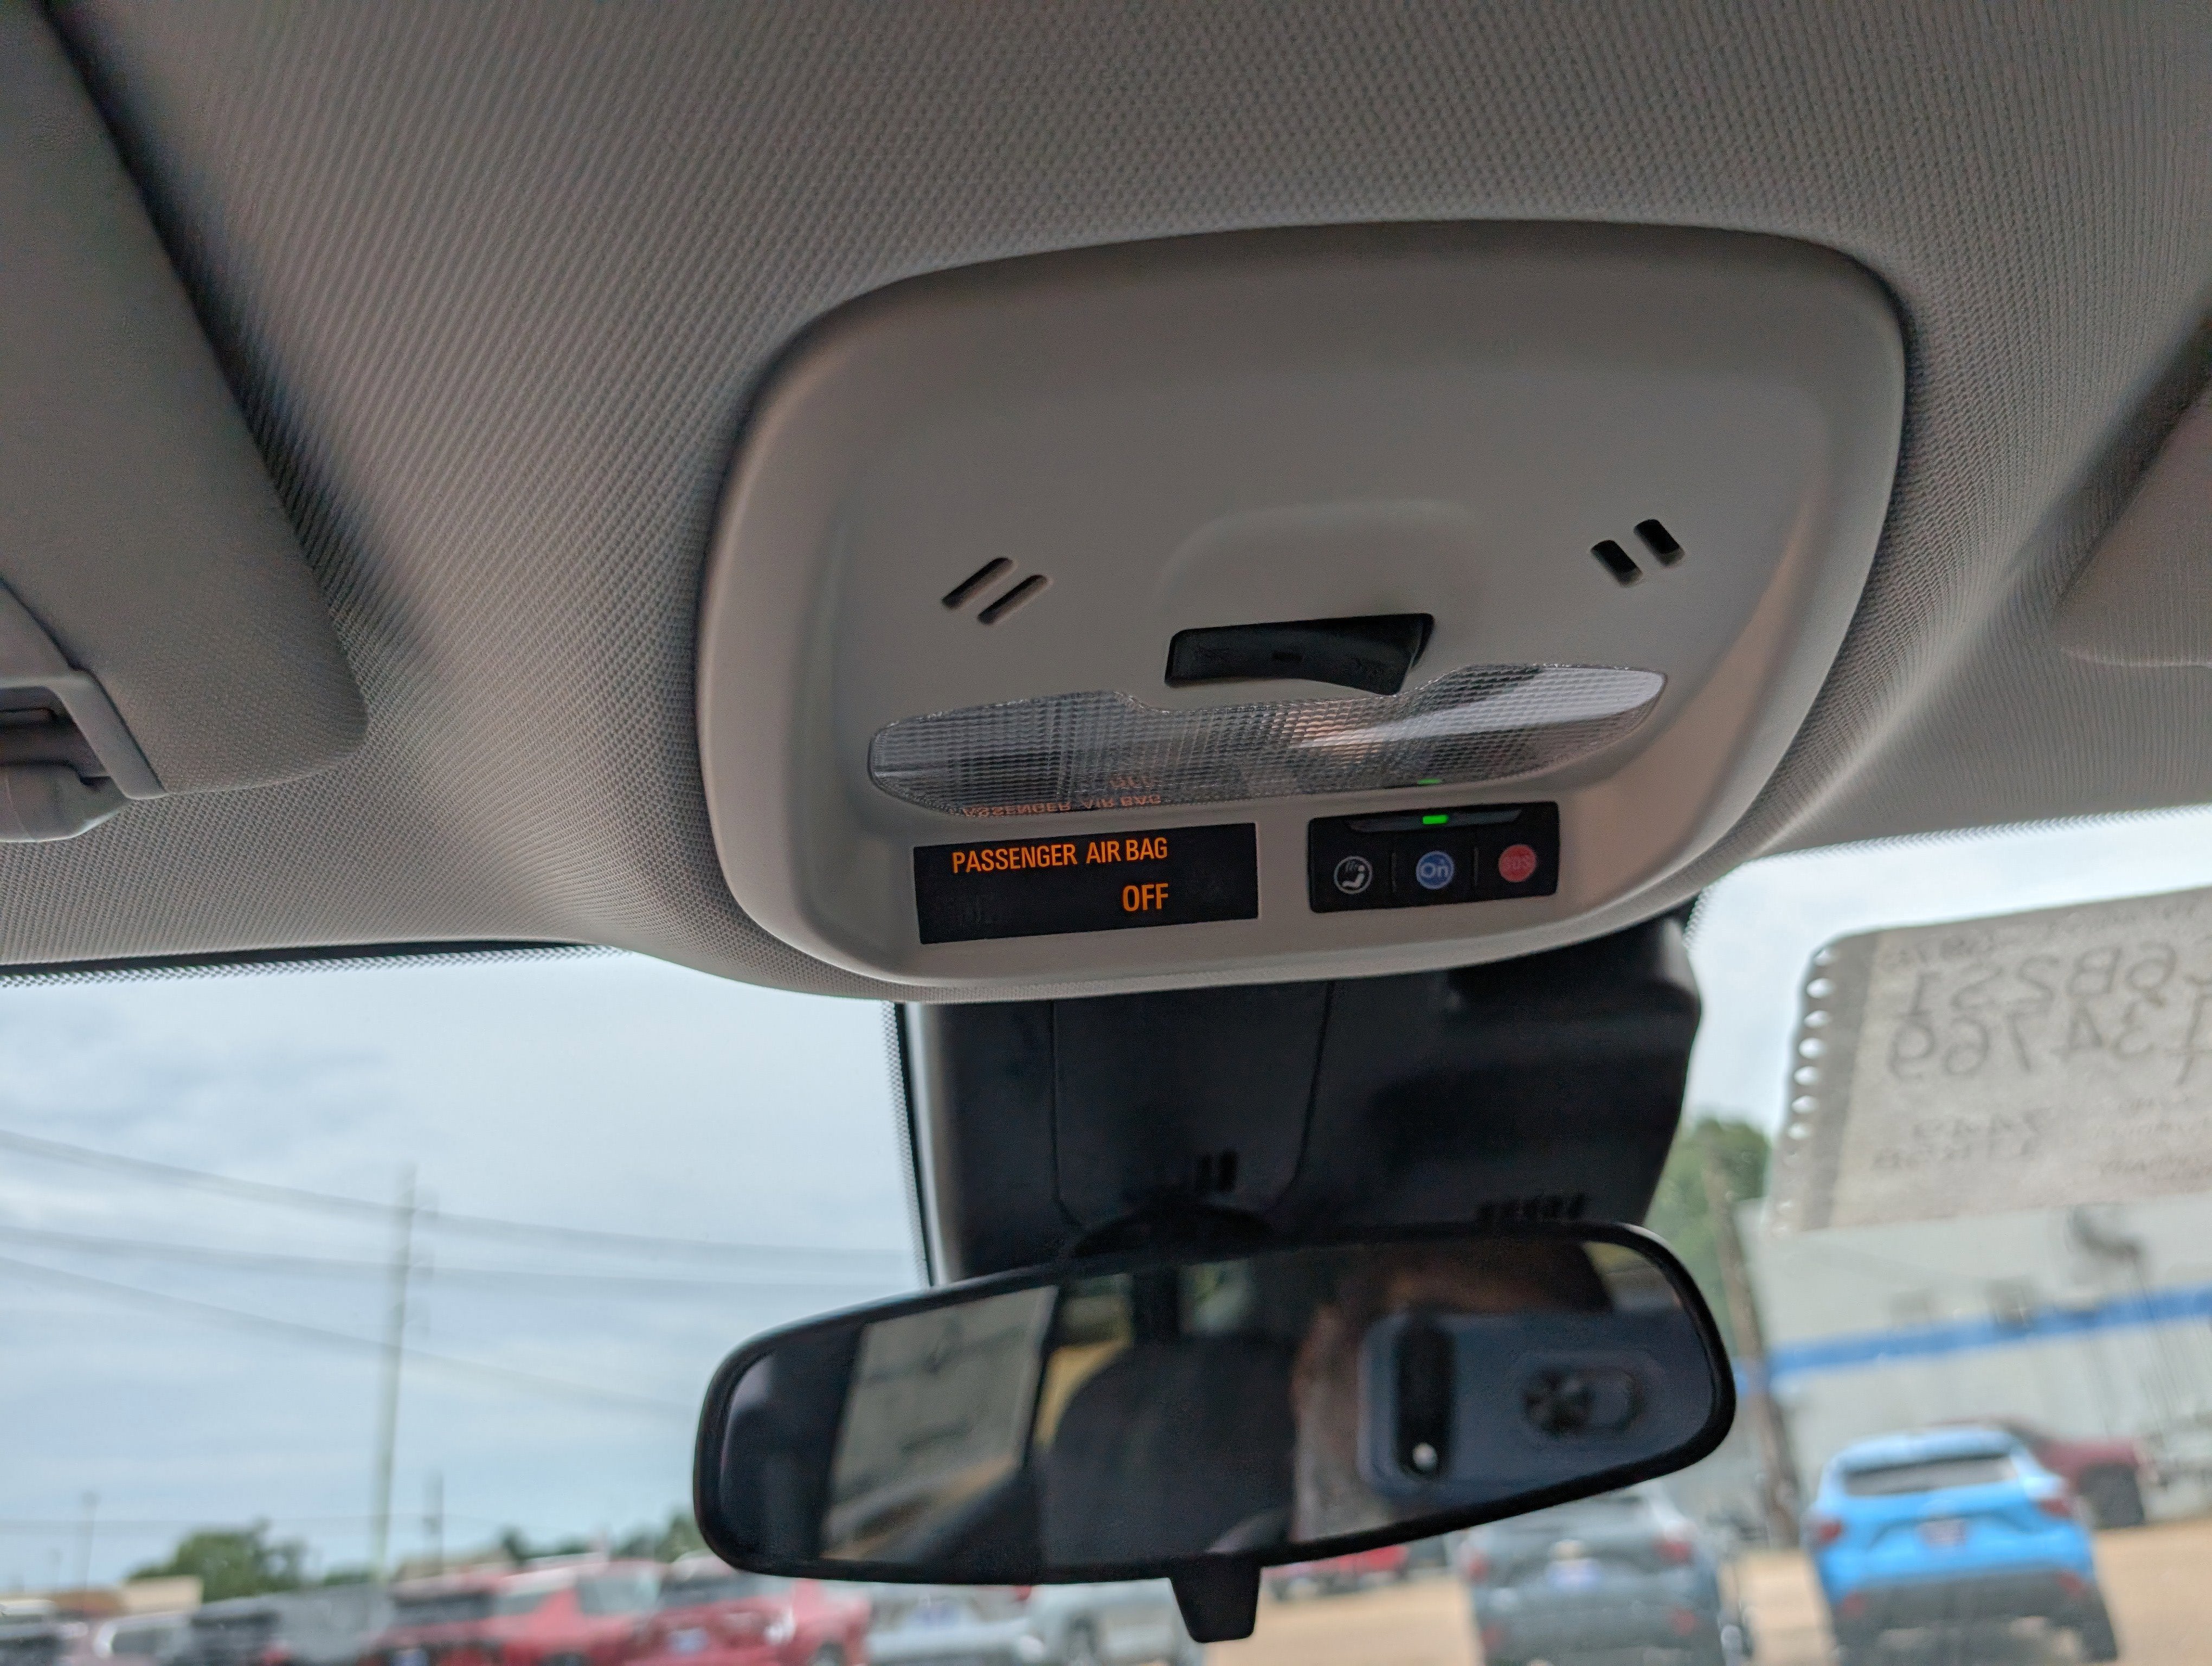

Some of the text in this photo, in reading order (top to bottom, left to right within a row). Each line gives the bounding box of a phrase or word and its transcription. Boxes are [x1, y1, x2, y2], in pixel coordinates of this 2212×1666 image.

[952, 837, 1168, 874] PASSENGER AIR BAG
[1420, 862, 1449, 879] On
[1122, 882, 1169, 912] OFF
